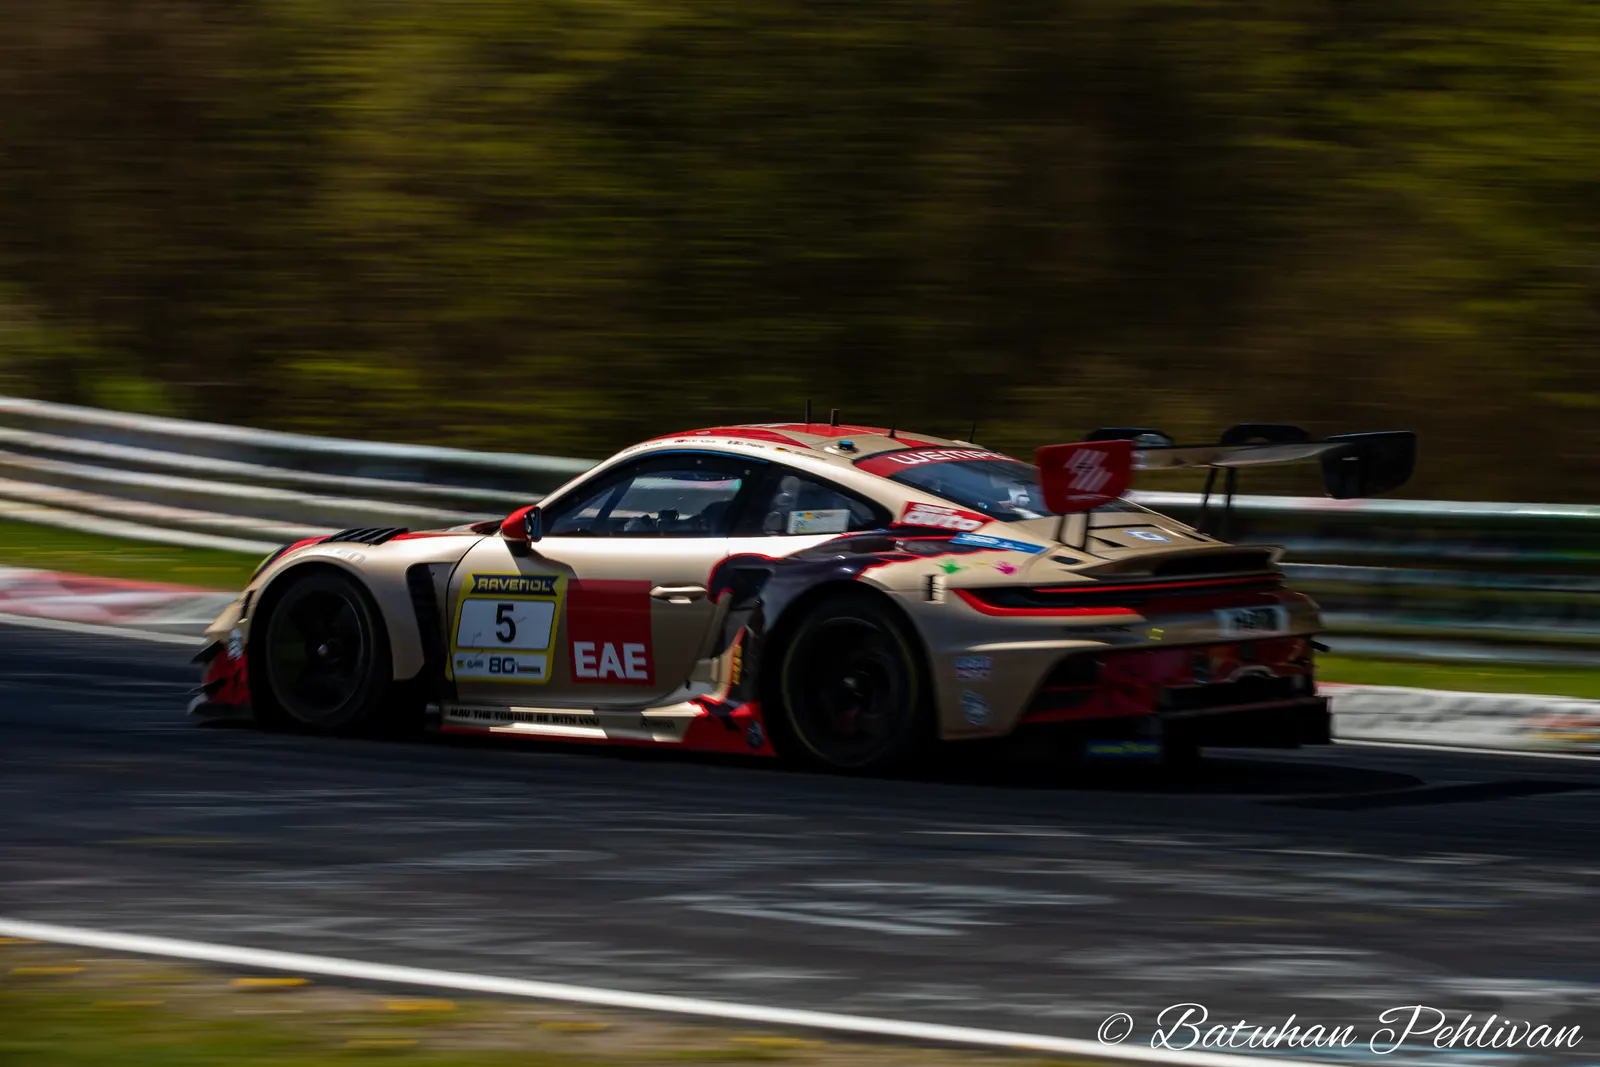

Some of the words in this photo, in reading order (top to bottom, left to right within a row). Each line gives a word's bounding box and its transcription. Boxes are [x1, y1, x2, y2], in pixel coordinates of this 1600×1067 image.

[477, 578, 551, 592] RAVENOL
[495, 604, 517, 643] 5
[573, 641, 648, 680] EAE
